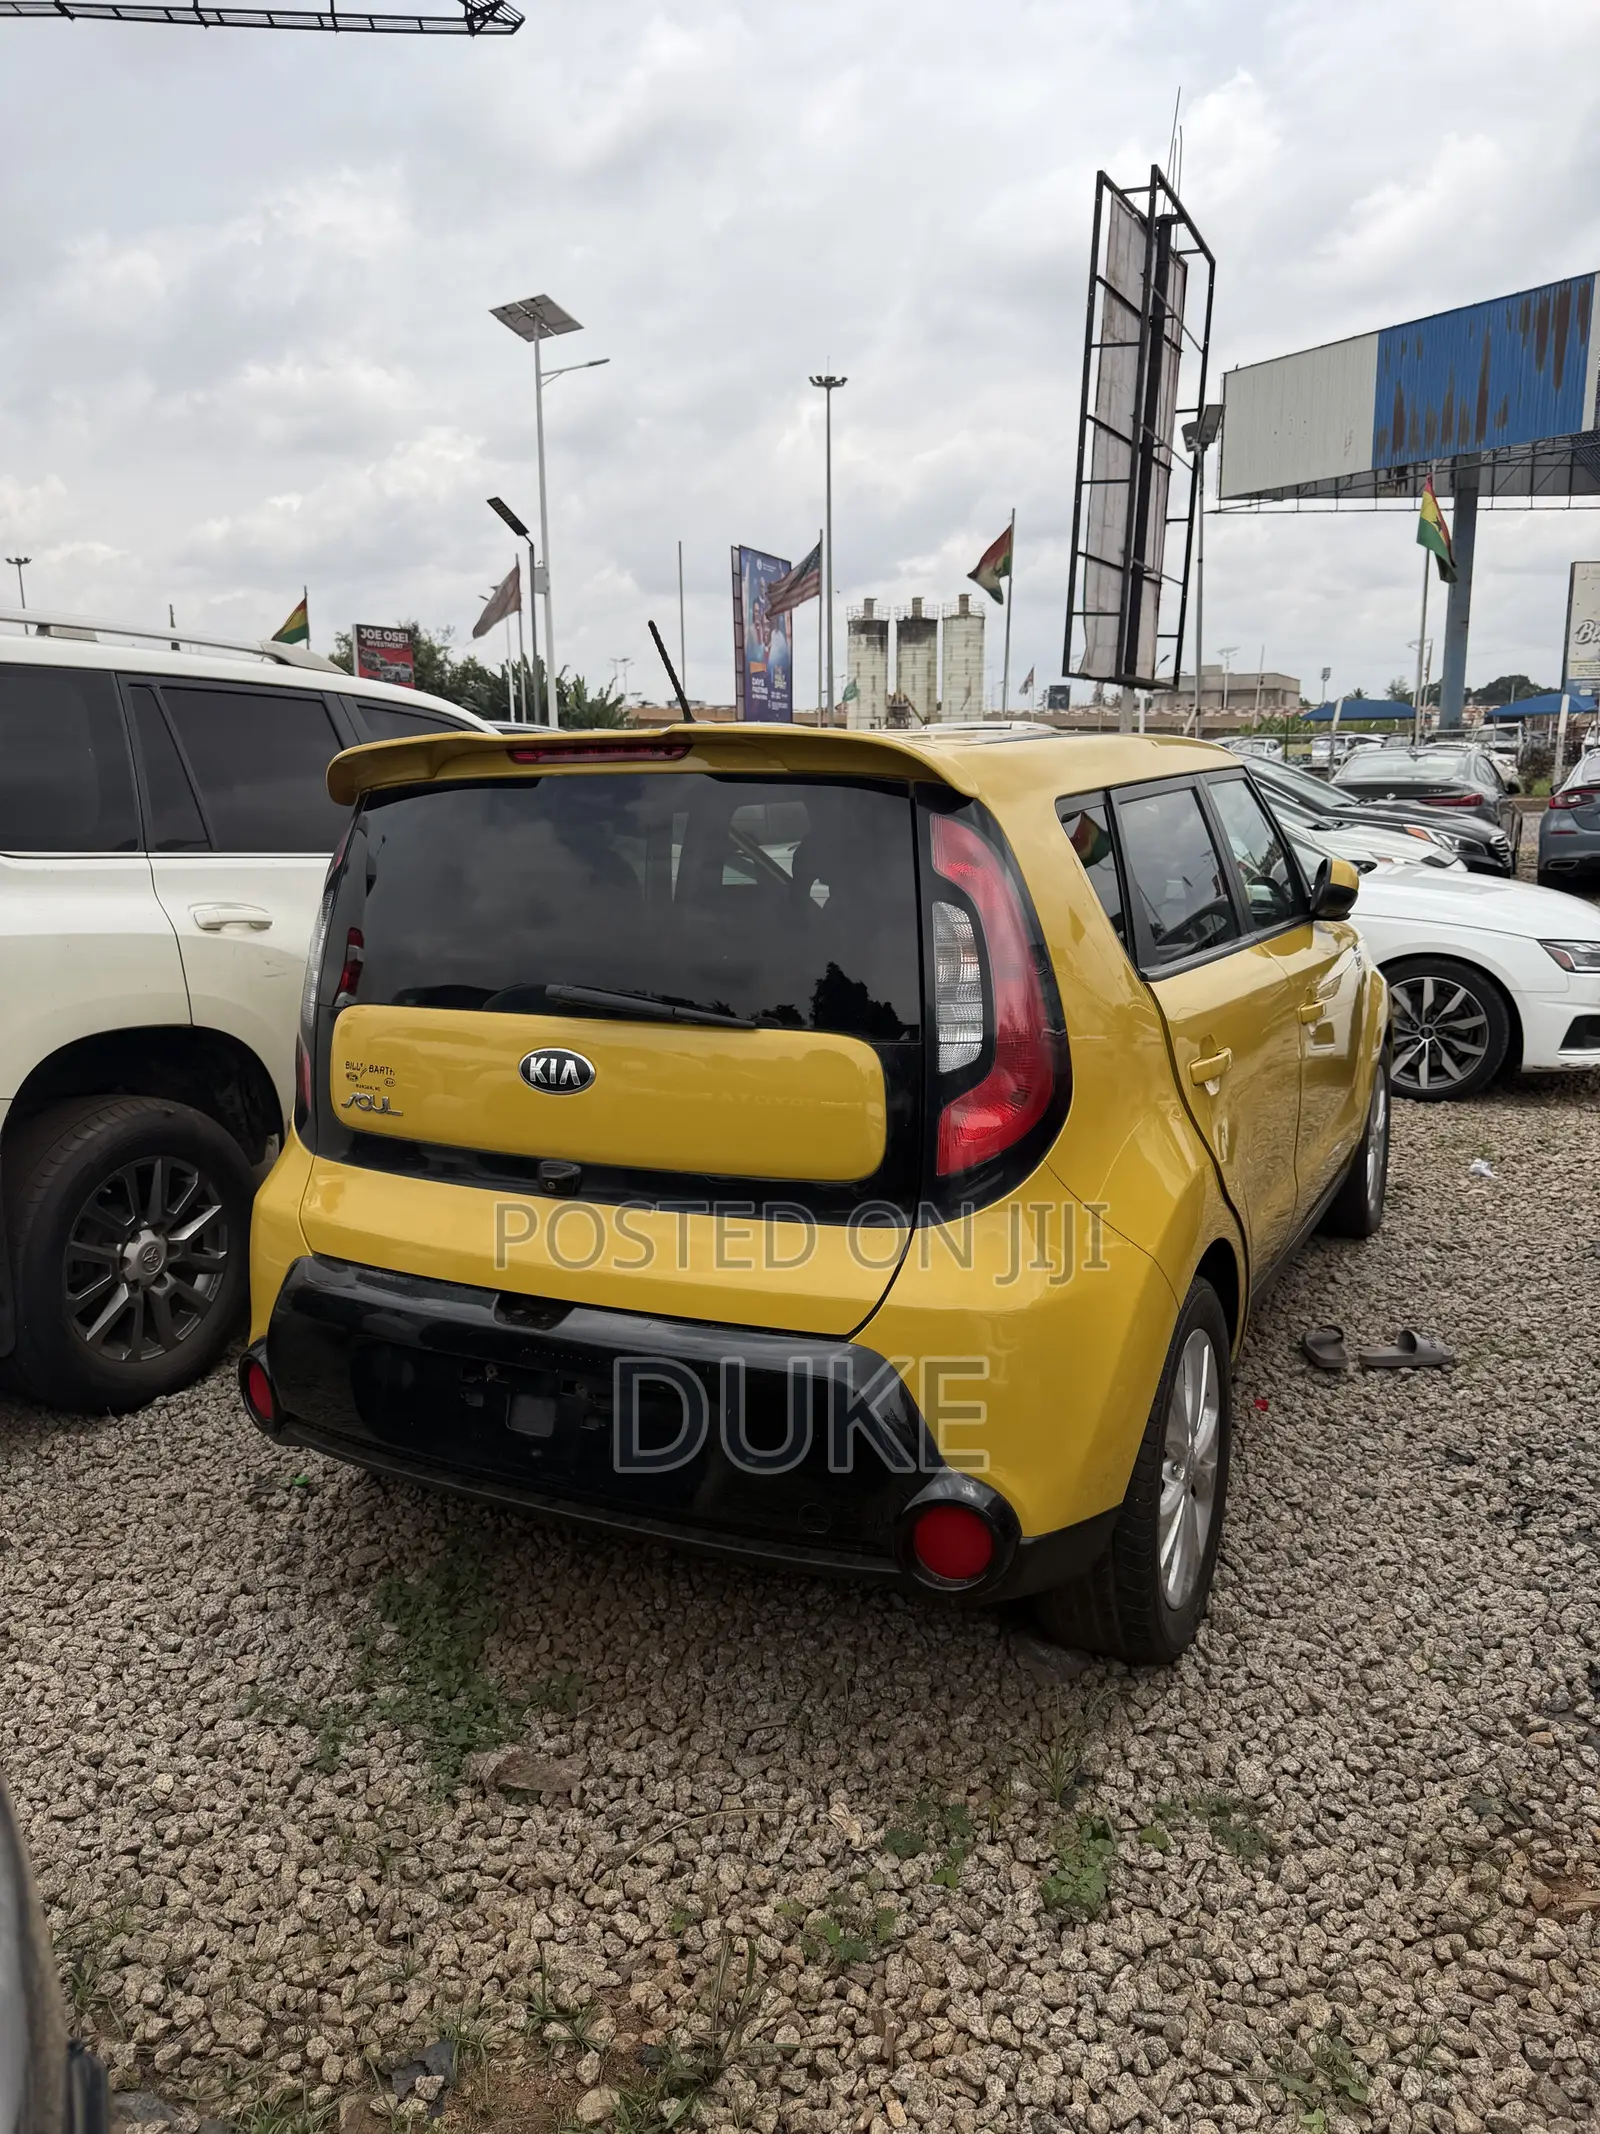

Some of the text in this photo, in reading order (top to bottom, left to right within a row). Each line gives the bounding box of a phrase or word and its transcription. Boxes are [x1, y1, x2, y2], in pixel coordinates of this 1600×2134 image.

[360, 628, 409, 643] JOE OSEI
[366, 640, 404, 649] INVESTMENT
[529, 1056, 581, 1086] KIA
